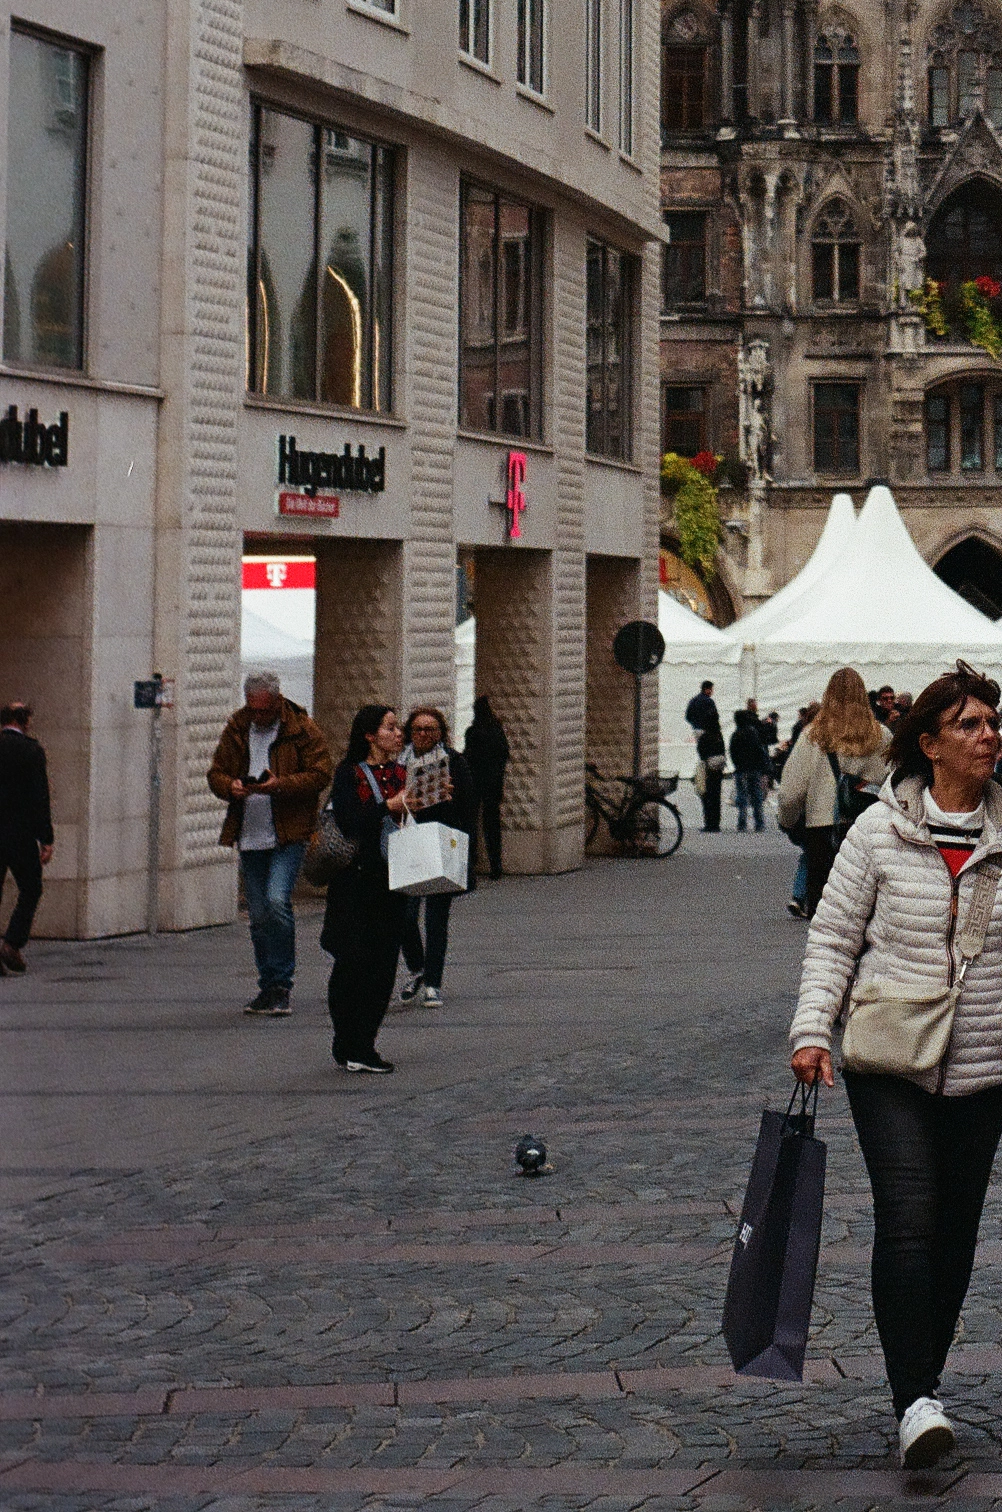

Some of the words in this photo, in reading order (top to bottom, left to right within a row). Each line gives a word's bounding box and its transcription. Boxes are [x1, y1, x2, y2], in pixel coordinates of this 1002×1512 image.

[0, 404, 69, 467] dubel
[279, 434, 386, 498] Hugendubel
[266, 563, 287, 587] T
